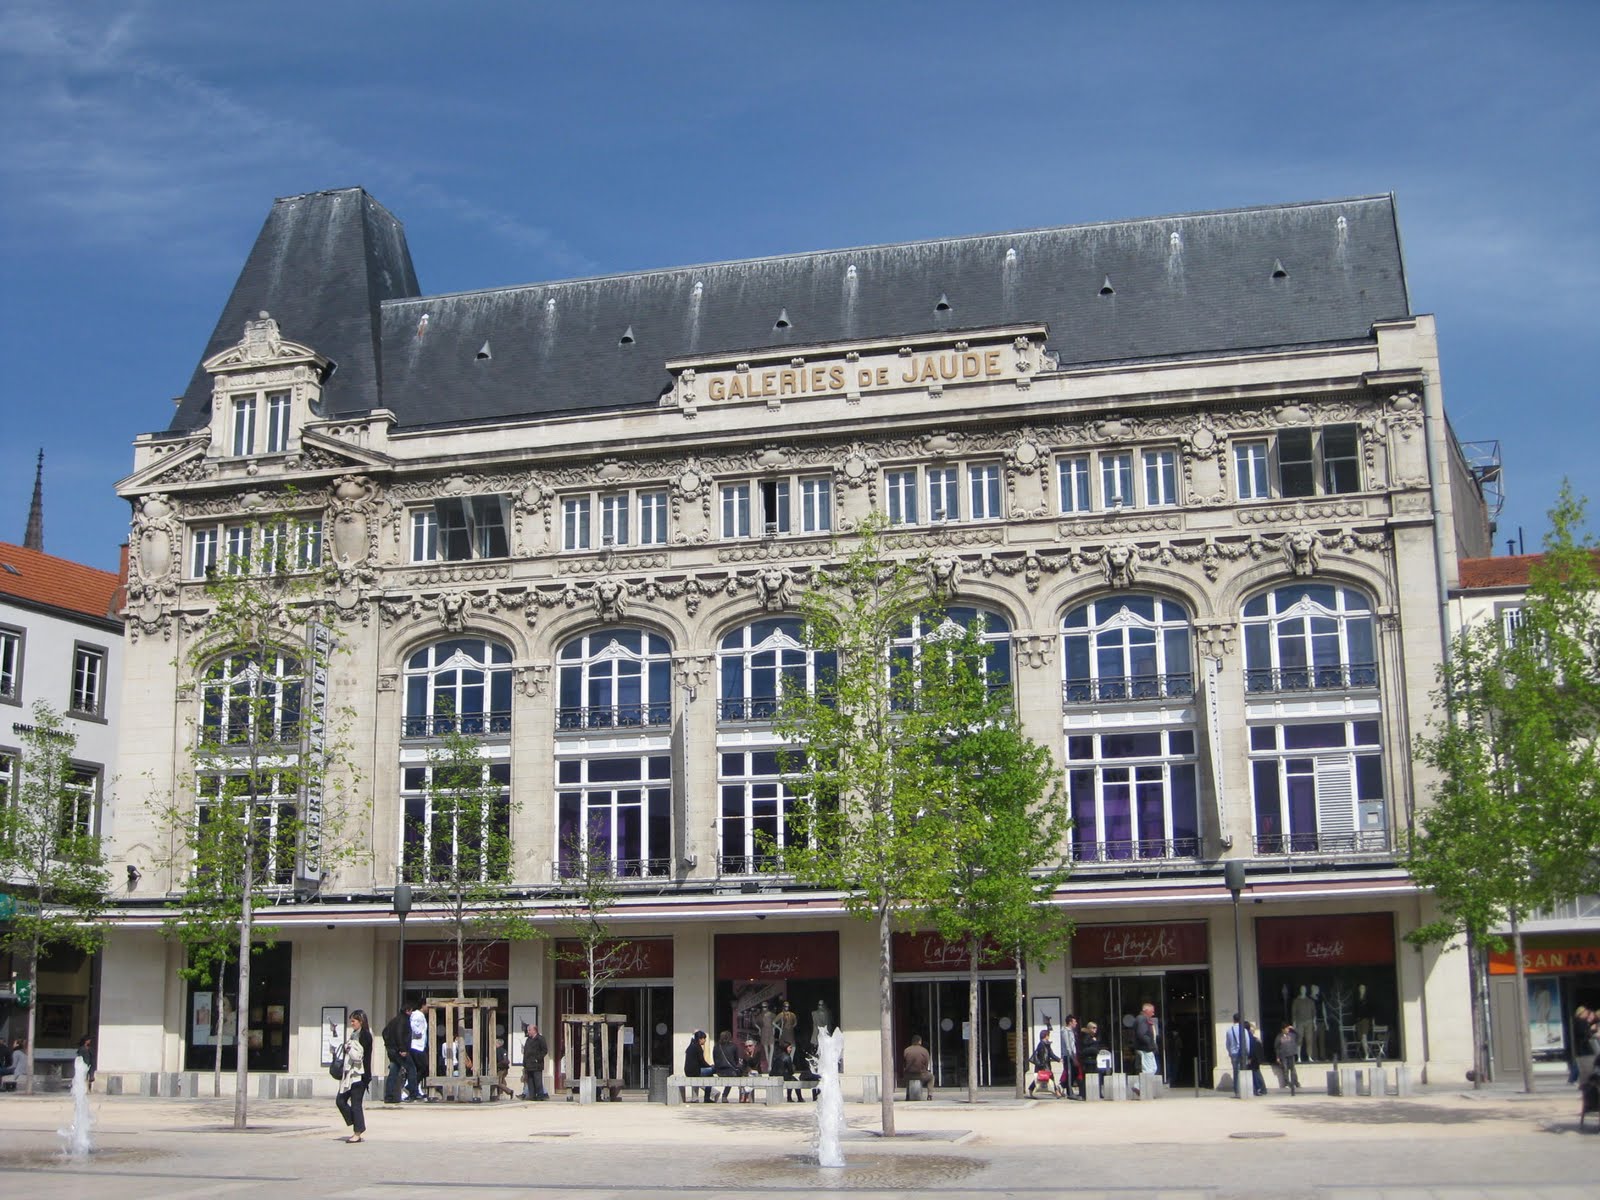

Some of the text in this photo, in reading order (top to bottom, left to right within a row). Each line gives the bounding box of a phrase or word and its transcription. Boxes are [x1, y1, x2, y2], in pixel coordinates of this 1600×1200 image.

[708, 351, 1002, 400] GALERIES DE JAUDE
